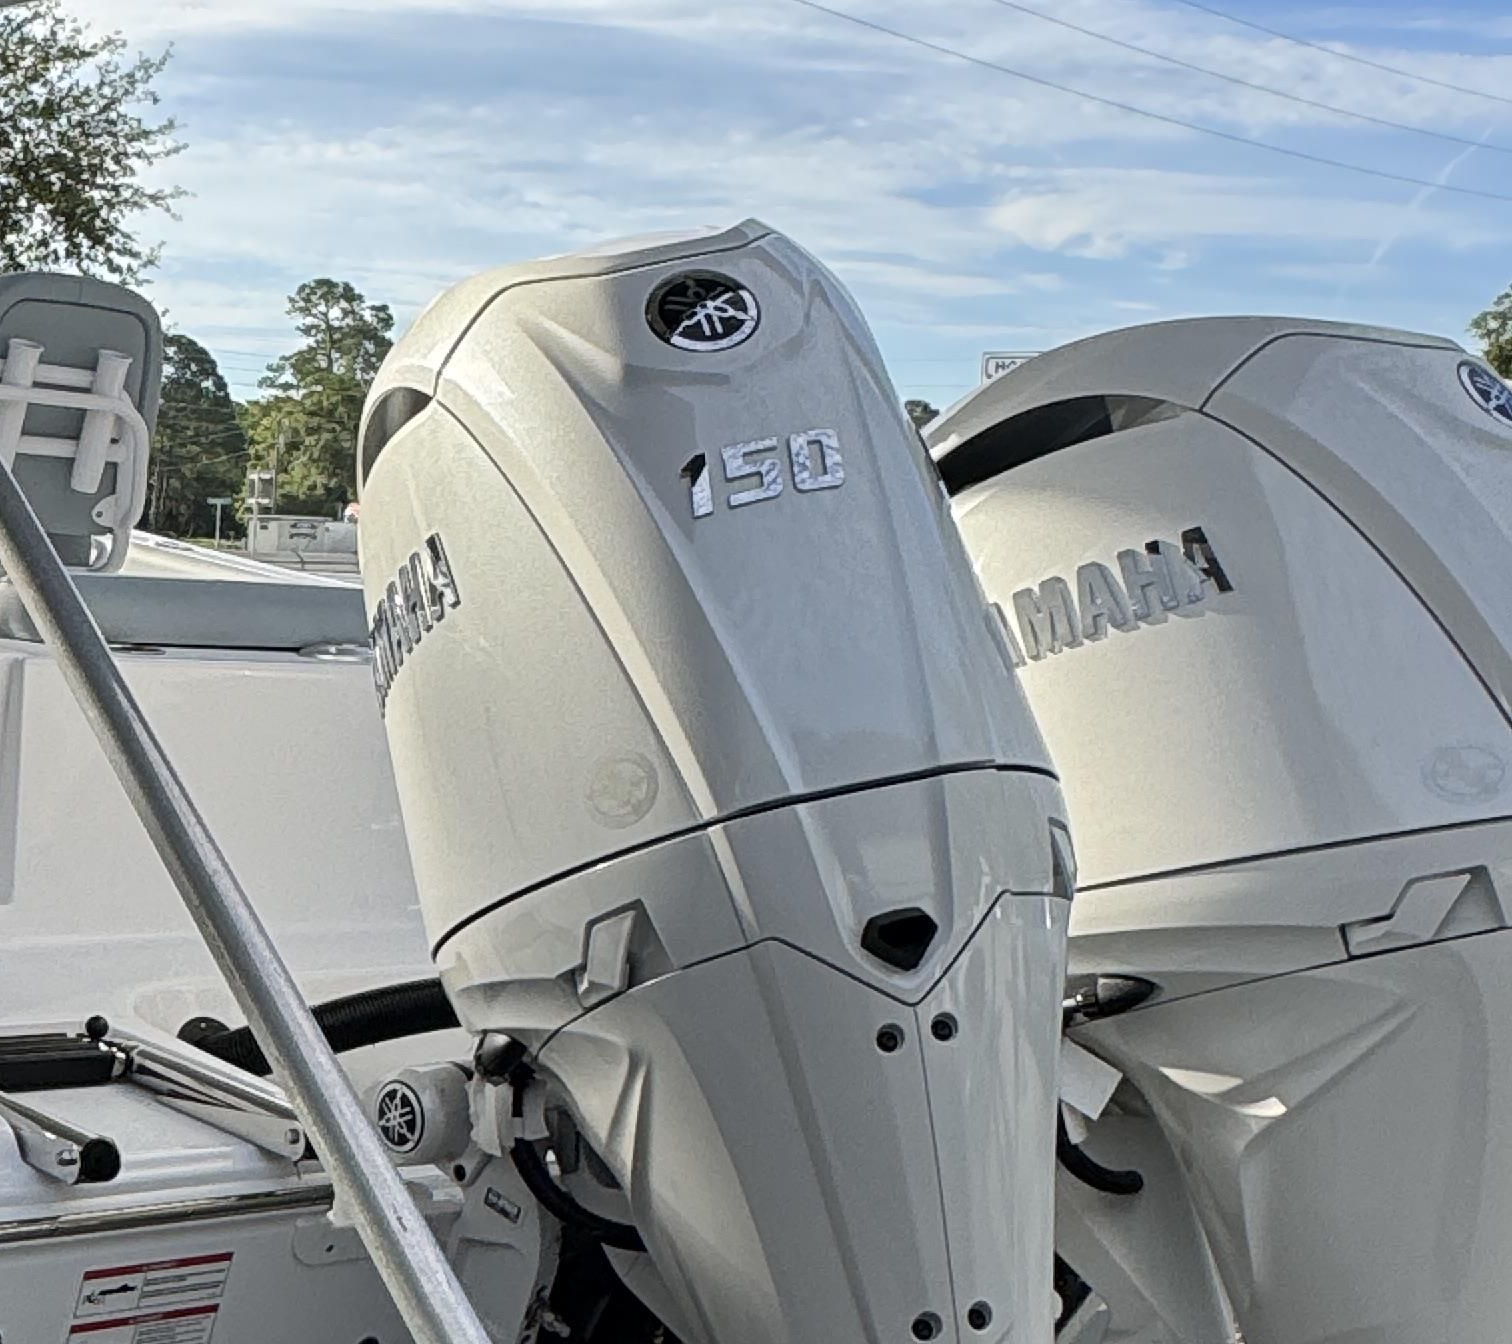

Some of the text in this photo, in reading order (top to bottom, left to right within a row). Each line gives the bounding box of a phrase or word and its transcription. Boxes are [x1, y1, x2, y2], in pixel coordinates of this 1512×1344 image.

[679, 428, 845, 519] 150
[368, 532, 462, 720] MAHA
[984, 525, 1234, 668] MAHA
